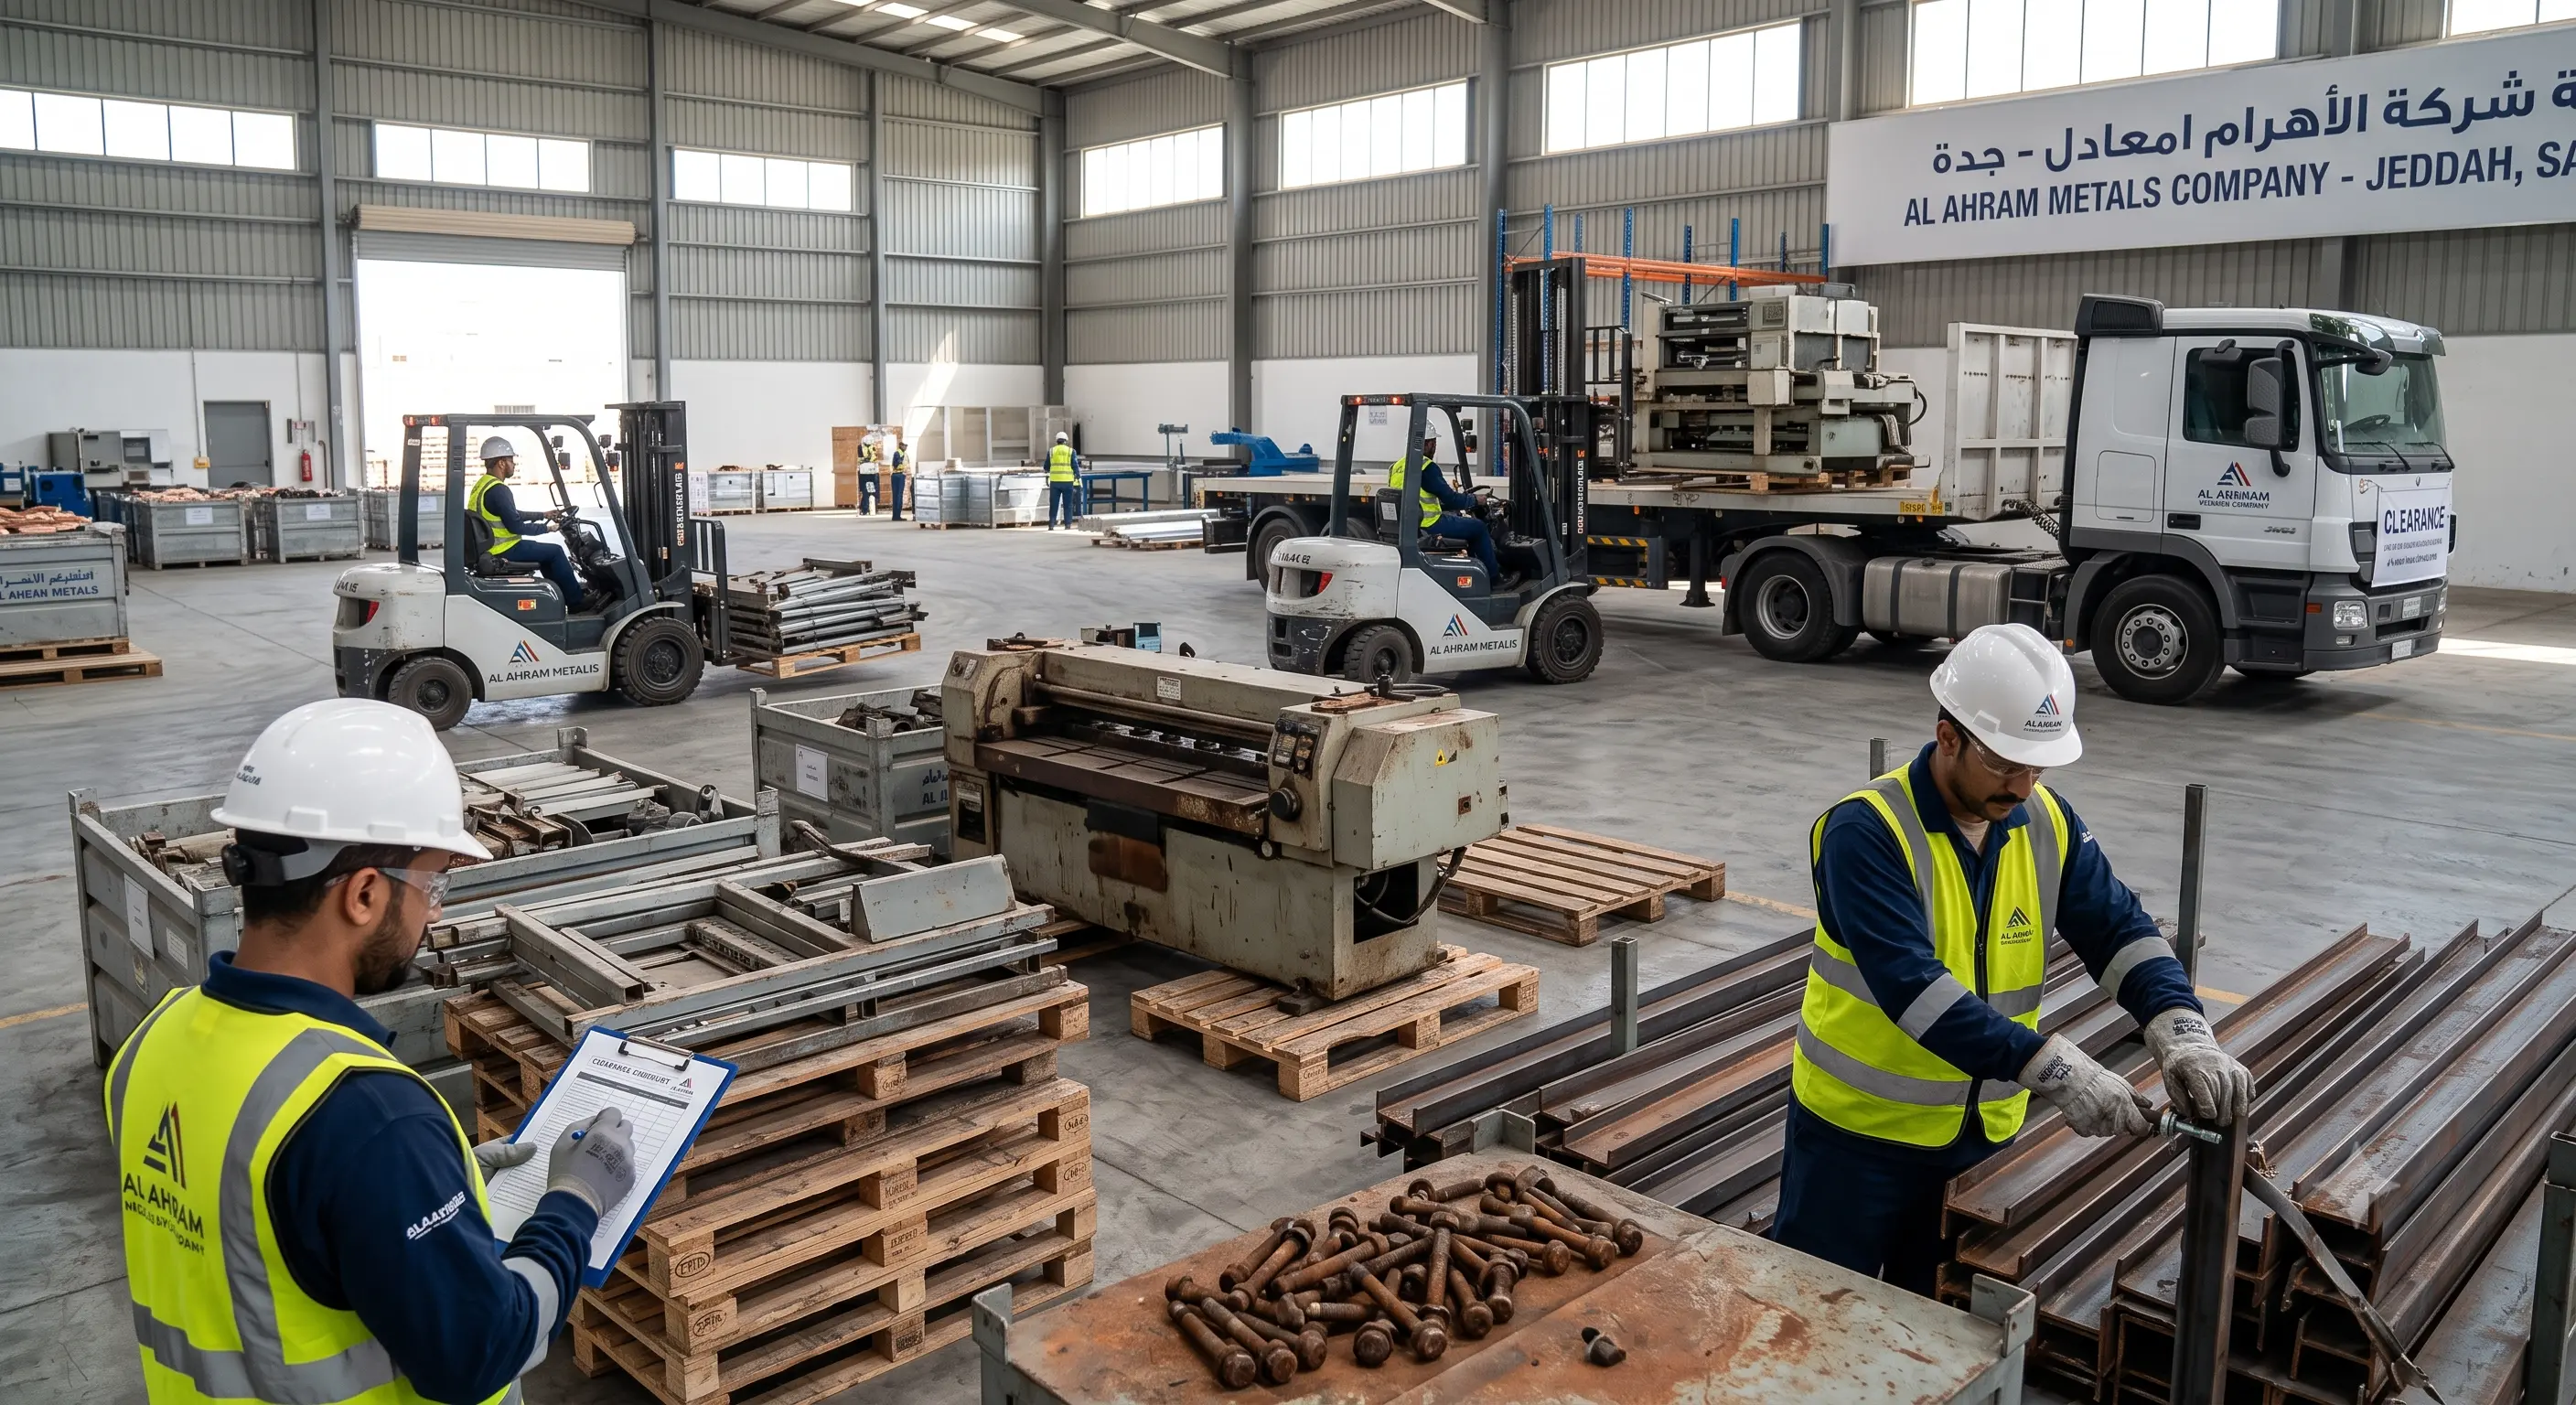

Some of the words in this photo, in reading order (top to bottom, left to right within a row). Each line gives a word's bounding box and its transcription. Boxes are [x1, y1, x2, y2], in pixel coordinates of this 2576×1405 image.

[2383, 70, 2535, 134] شركة
[2205, 84, 2368, 159] الأهرام
[1933, 143, 2005, 177] جدة
[1904, 197, 1936, 227] AL
[1942, 188, 2038, 224] AHRAM
[2048, 177, 2162, 216] METALS
[2172, 161, 2330, 206] COMPANY
[2366, 145, 2523, 191] JEDDAH,
[2197, 489, 2213, 499] AL
[2384, 505, 2446, 534] CLEARANCE
[52, 585, 99, 597] METALS
[1430, 646, 1442, 656] AL
[1444, 642, 1478, 654] AHRAM
[1480, 639, 1518, 651] METALIS
[488, 673, 504, 683] AL
[506, 668, 550, 682] AHRAM
[553, 663, 599, 677] METALIS
[123, 1173, 145, 1200] AL
